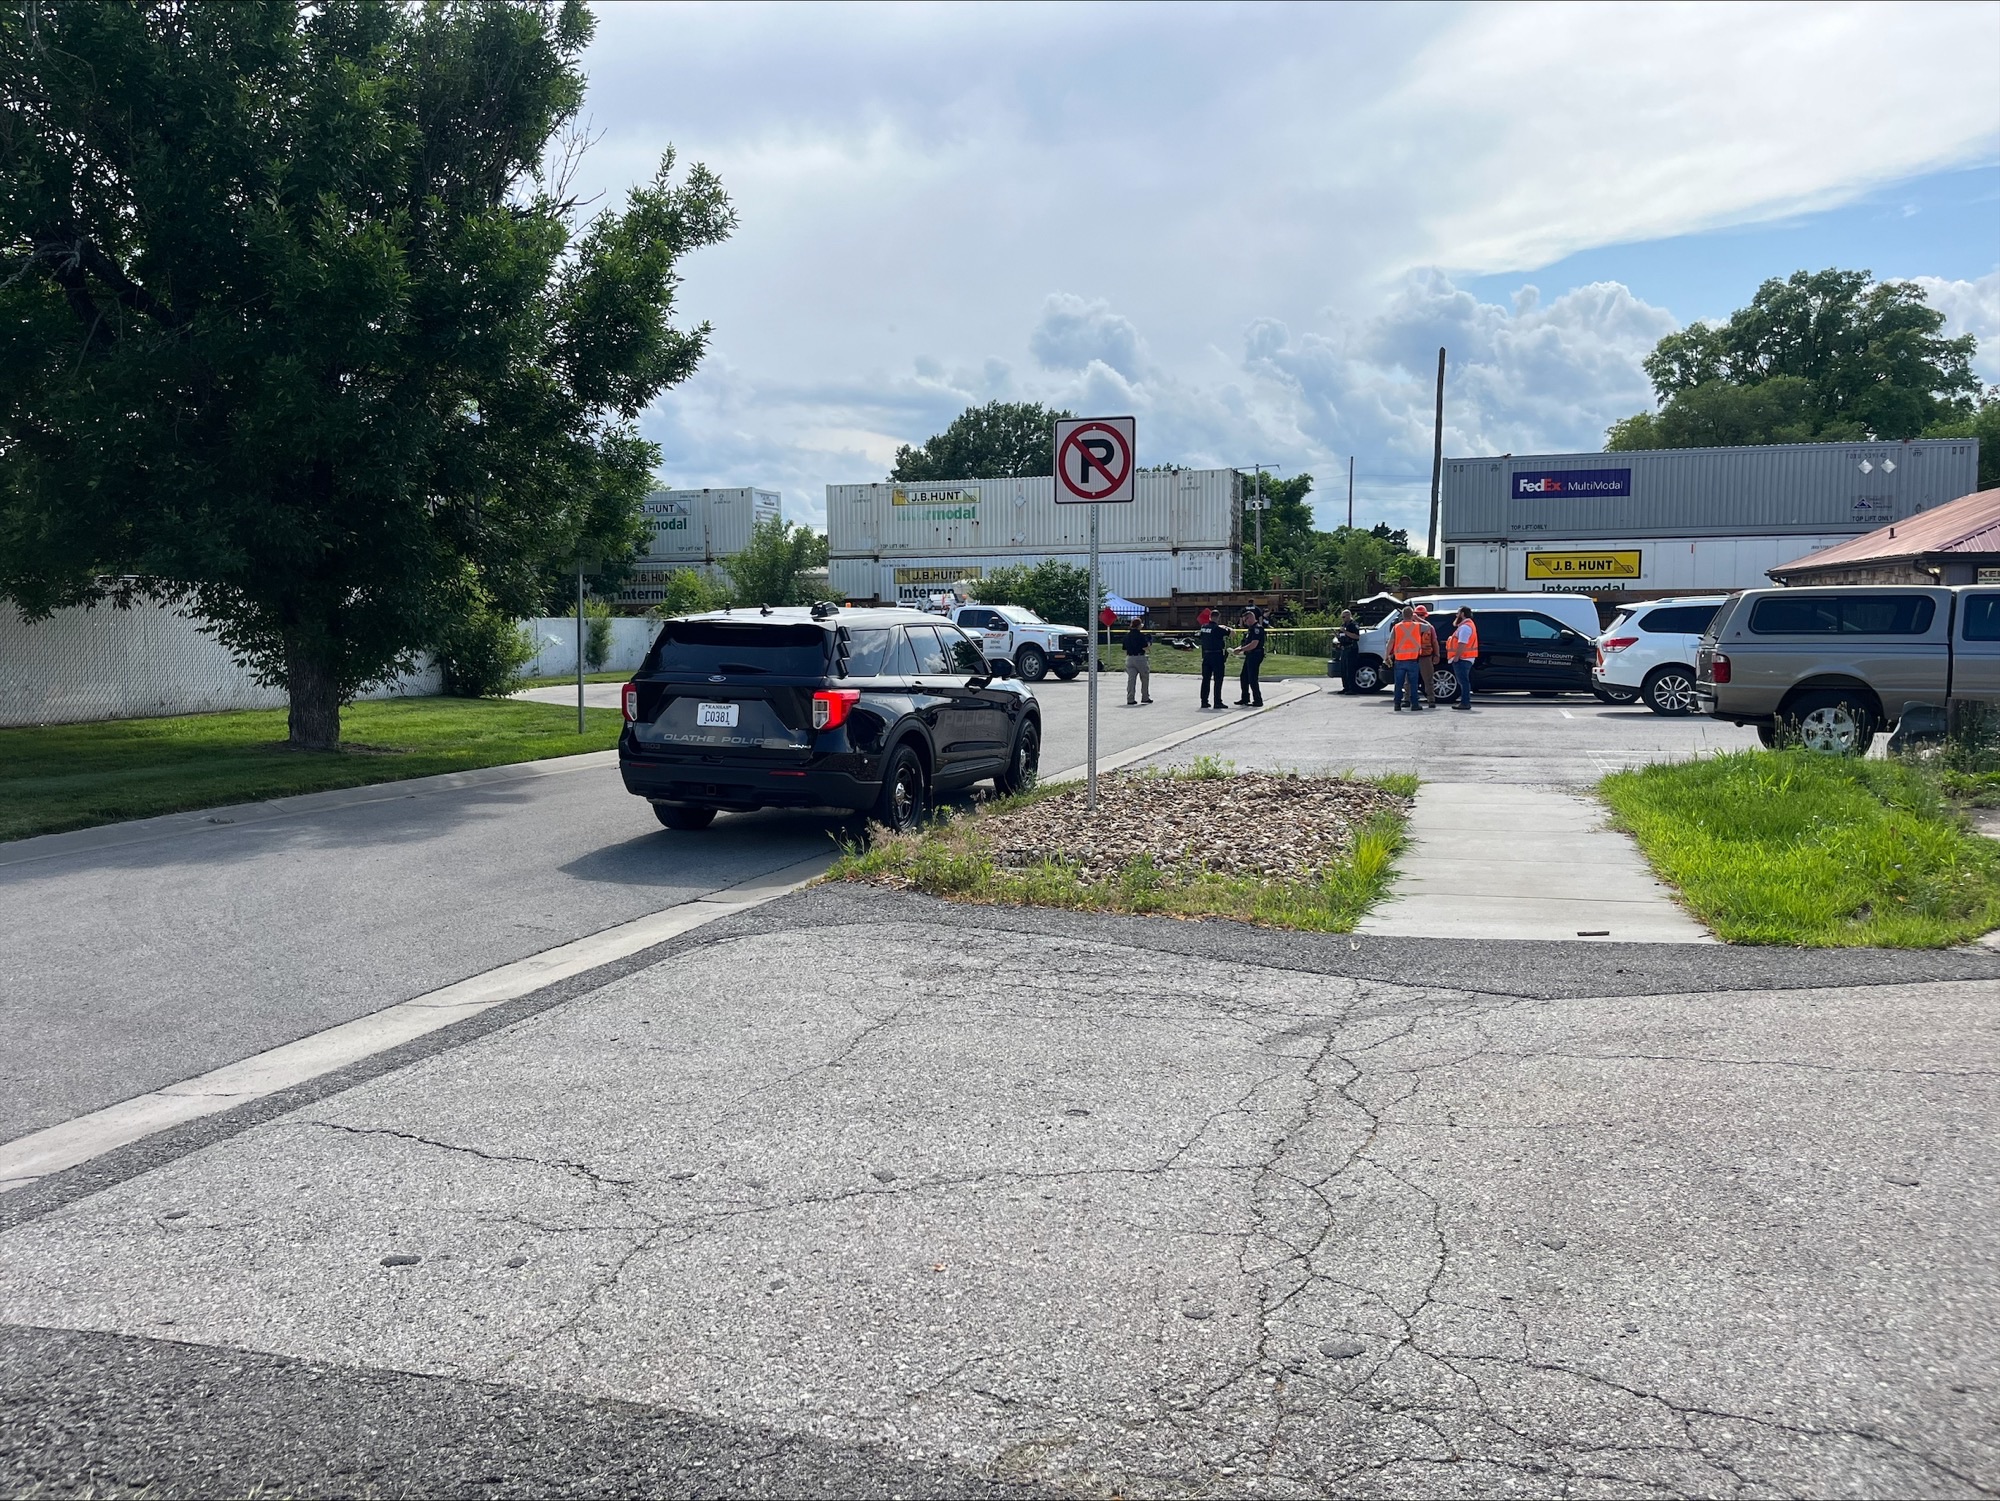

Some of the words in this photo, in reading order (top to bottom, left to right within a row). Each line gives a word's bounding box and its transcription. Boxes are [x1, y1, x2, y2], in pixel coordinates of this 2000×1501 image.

[1080, 439, 1114, 484] P
[1519, 479, 1561, 492] FedEx
[1568, 481, 1623, 491] MultiModal
[1578, 560, 1613, 571] HUNT
[663, 733, 716, 742] OLATHE
[721, 736, 774, 746] POLICE
